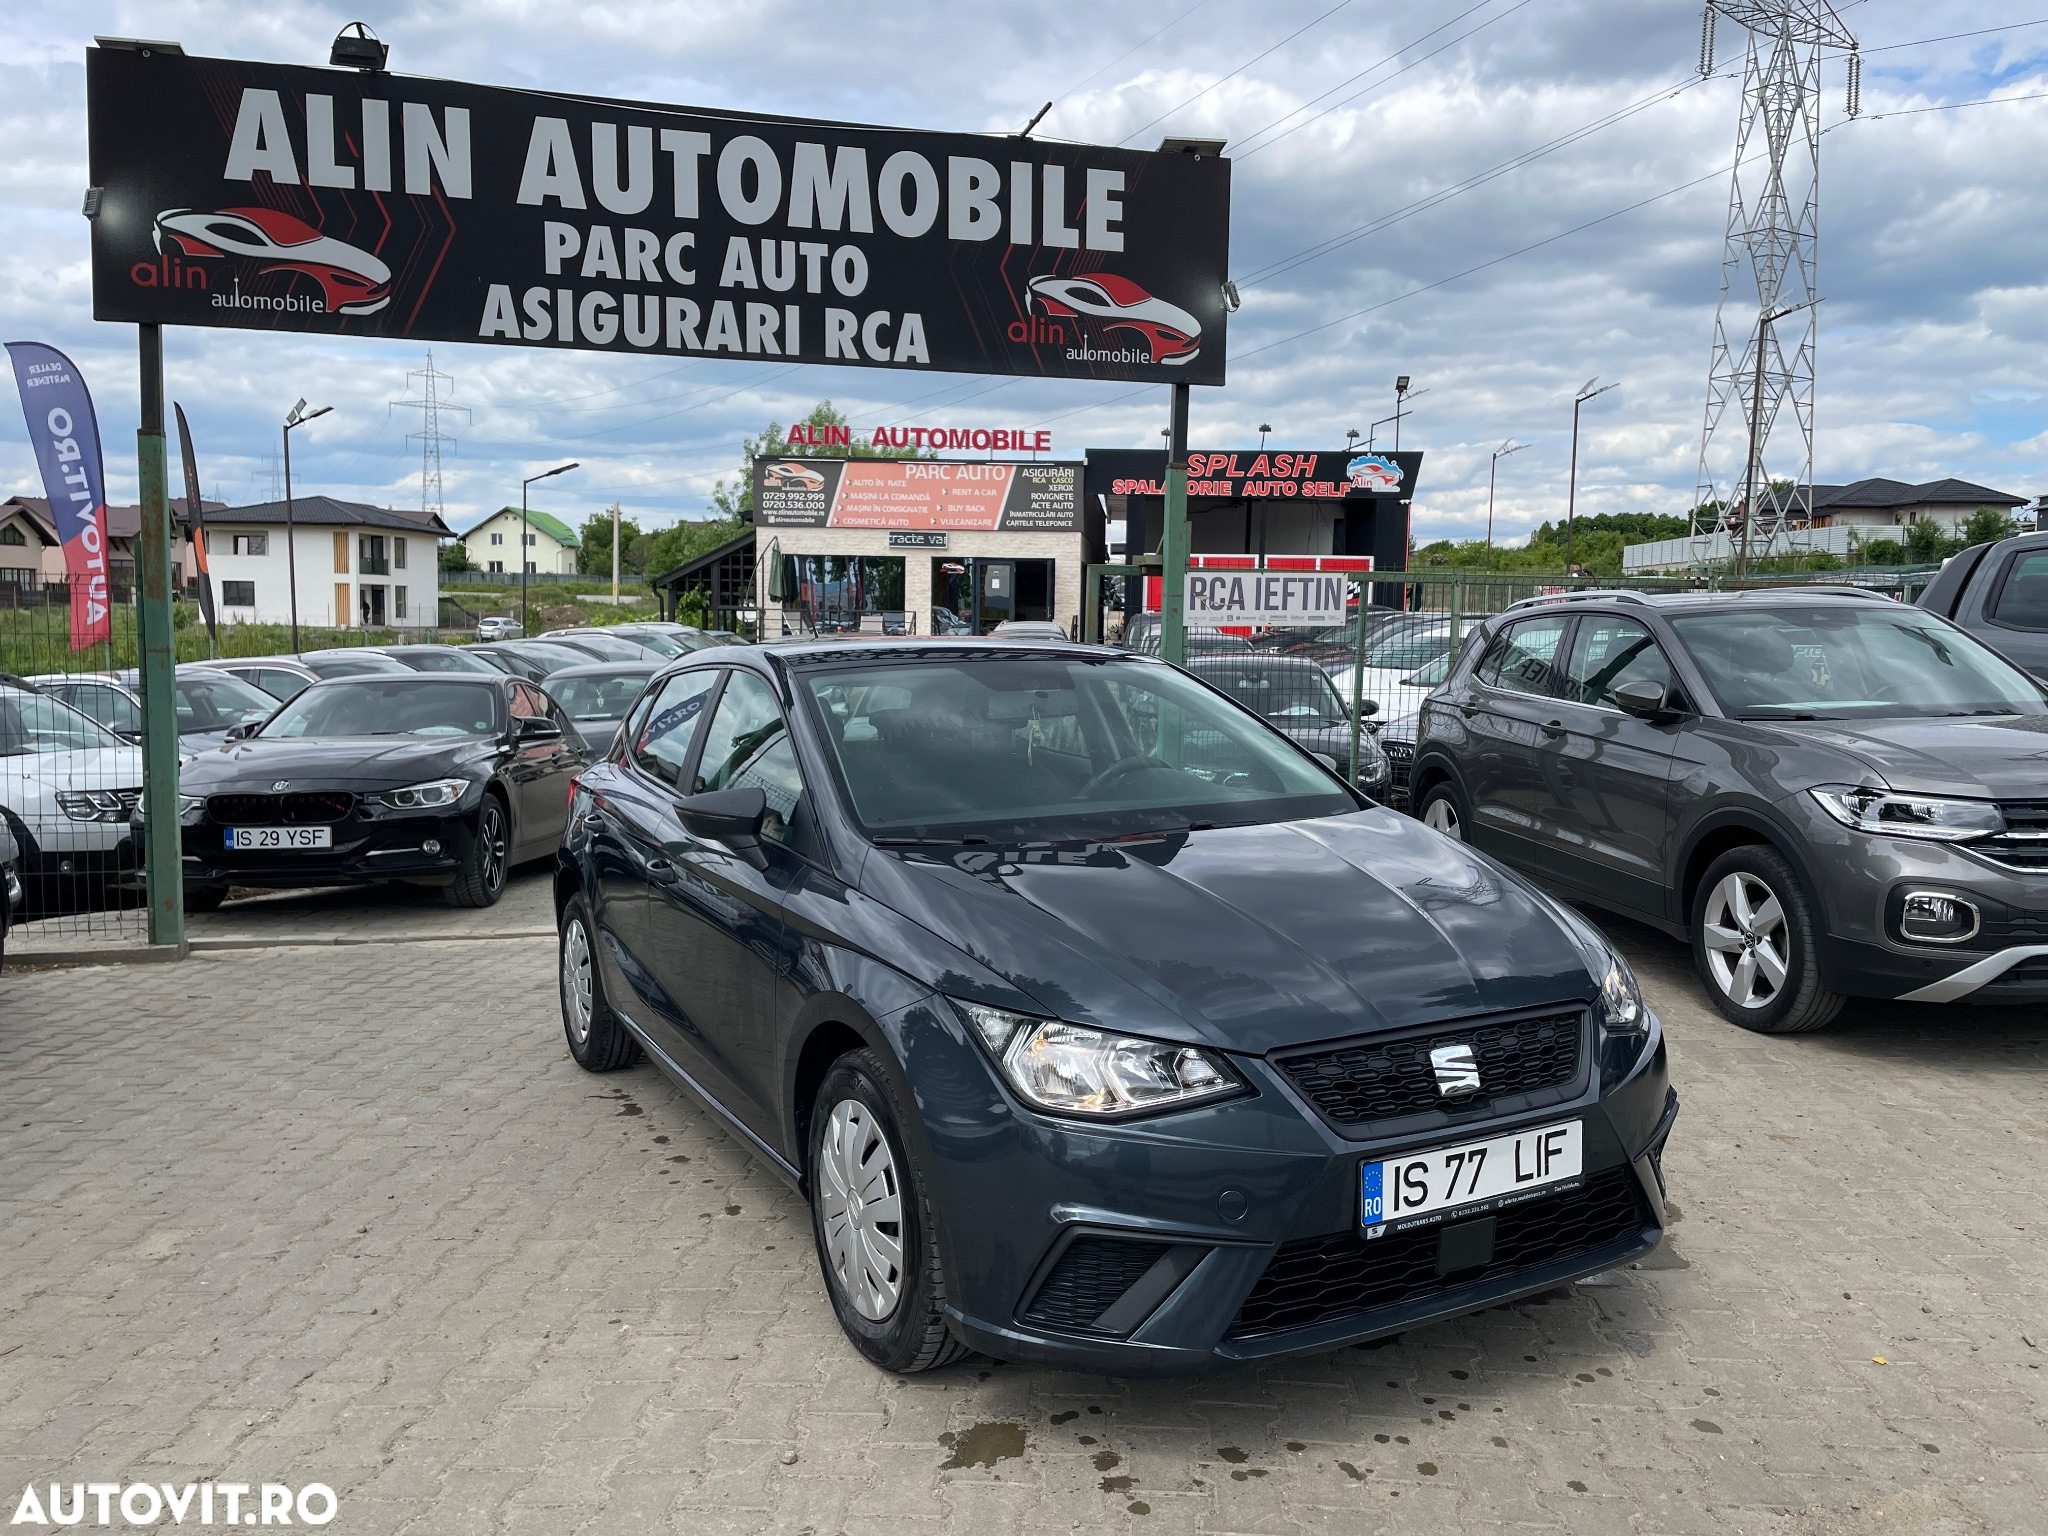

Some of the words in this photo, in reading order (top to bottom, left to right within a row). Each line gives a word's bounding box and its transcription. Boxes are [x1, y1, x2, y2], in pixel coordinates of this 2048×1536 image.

[223, 88, 473, 199] ALIN
[517, 116, 1124, 252] AUTOMOBILE
[544, 221, 695, 286] PARC
[719, 236, 868, 297] AUTO
[131, 255, 207, 289] alin
[211, 287, 324, 312] automobile
[478, 284, 799, 356] ASIGURARI
[825, 307, 930, 364] RCA
[1007, 321, 1064, 345] alin
[1066, 343, 1151, 365] automobile
[787, 424, 850, 446] ALIN
[872, 427, 1051, 452] AUTOMOBILE
[905, 464, 951, 479] PARC
[956, 465, 1005, 480] AUTO
[1022, 467, 1074, 478] ASIGURĂRI
[1187, 454, 1317, 477] SPLASH
[853, 479, 874, 487] AUTO
[875, 478, 884, 487] ÎN
[1112, 479, 1232, 496] SPALORIE
[1242, 481, 1297, 496] AUTO
[1302, 481, 1351, 497] SELF
[1352, 478, 1372, 486] Alin
[763, 492, 825, 500] 0729.992.999
[763, 500, 825, 509] 0720.536.000
[891, 493, 931, 501] COMANDĂ
[843, 517, 885, 525] COSMETICĂ
[888, 518, 909, 526] AUTO
[941, 518, 992, 526] VULCANIZARE
[1190, 576, 1246, 611] RCA
[1255, 577, 1342, 611] IEFTIN
[236, 830, 252, 846] IS
[260, 830, 279, 846] 29
[286, 829, 325, 846] YSF
[1365, 1196, 1382, 1218] RO
[1392, 1161, 1429, 1212] IS
[1445, 1147, 1488, 1200] 77
[1514, 1129, 1568, 1183] LIF
